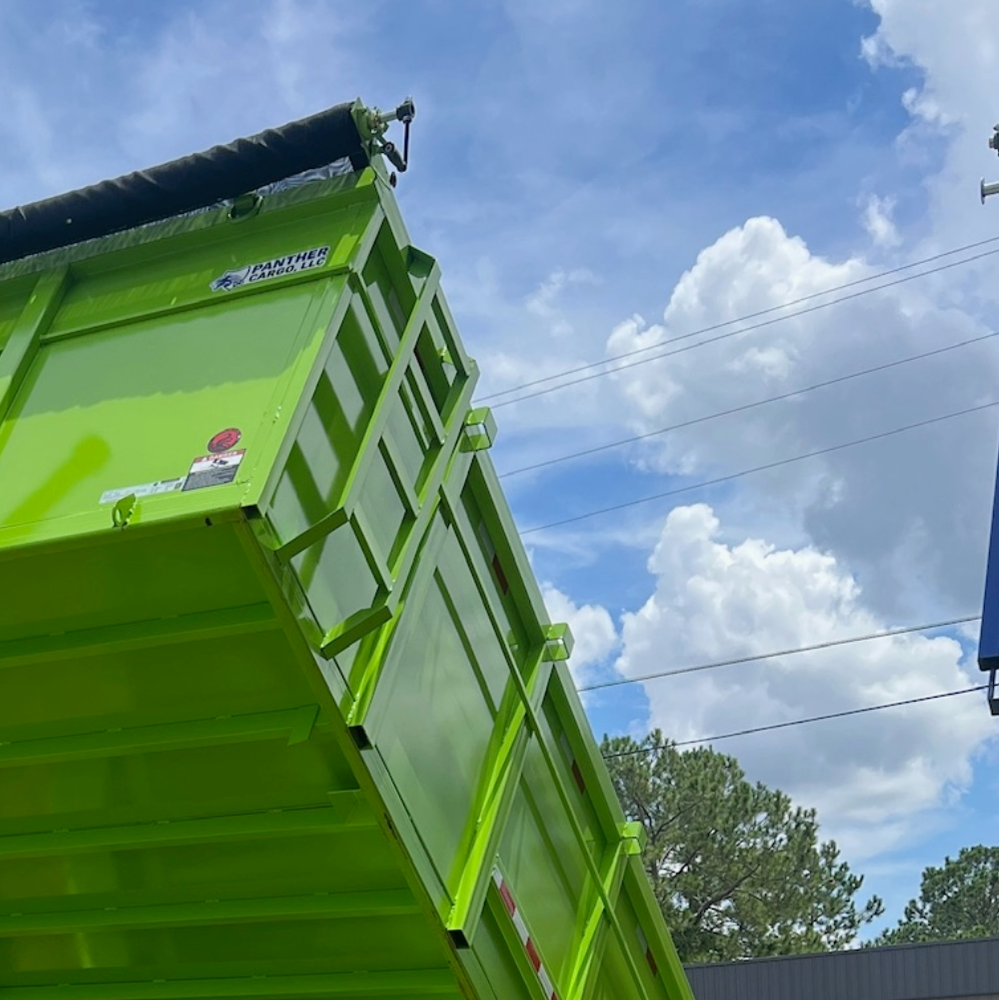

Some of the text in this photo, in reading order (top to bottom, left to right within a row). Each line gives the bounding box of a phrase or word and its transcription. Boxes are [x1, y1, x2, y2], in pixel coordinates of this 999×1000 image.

[249, 257, 326, 282] CARGO, LLC
[251, 247, 329, 274] PANTHER
